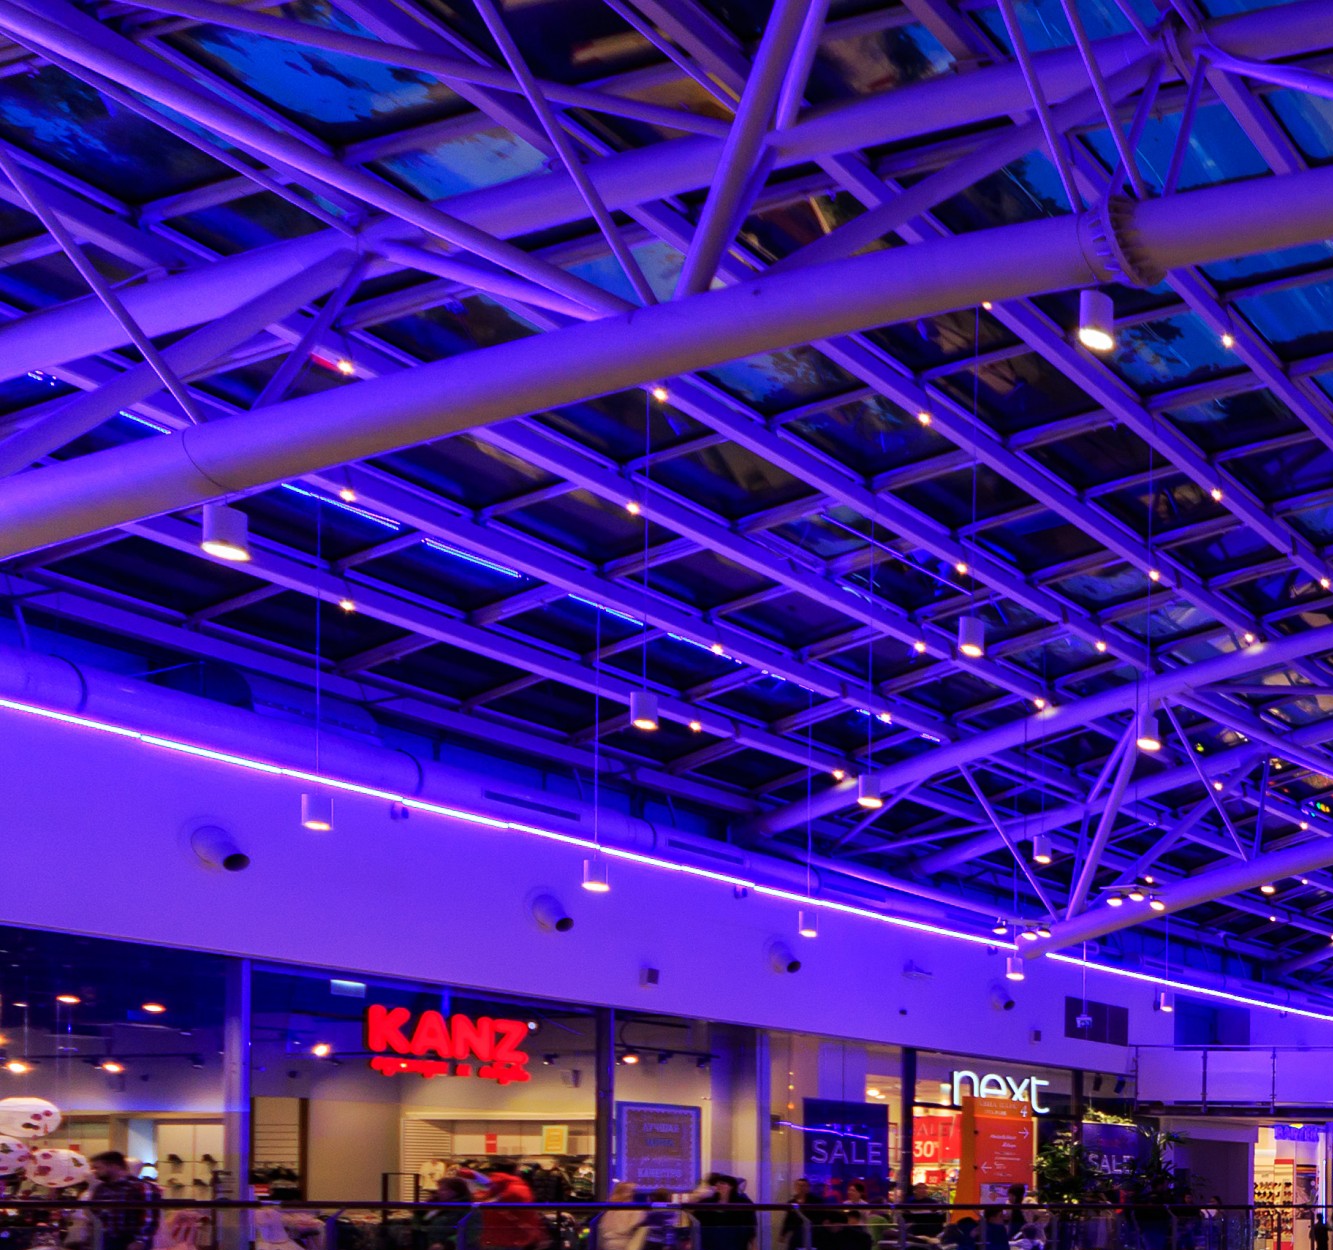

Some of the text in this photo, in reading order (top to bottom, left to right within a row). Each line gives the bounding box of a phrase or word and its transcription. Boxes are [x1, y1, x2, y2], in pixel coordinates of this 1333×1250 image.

[368, 1004, 529, 1064] KANZ
[953, 1070, 1049, 1114] next
[1019, 1105, 1028, 1118] 4
[811, 1139, 882, 1165] SALE
